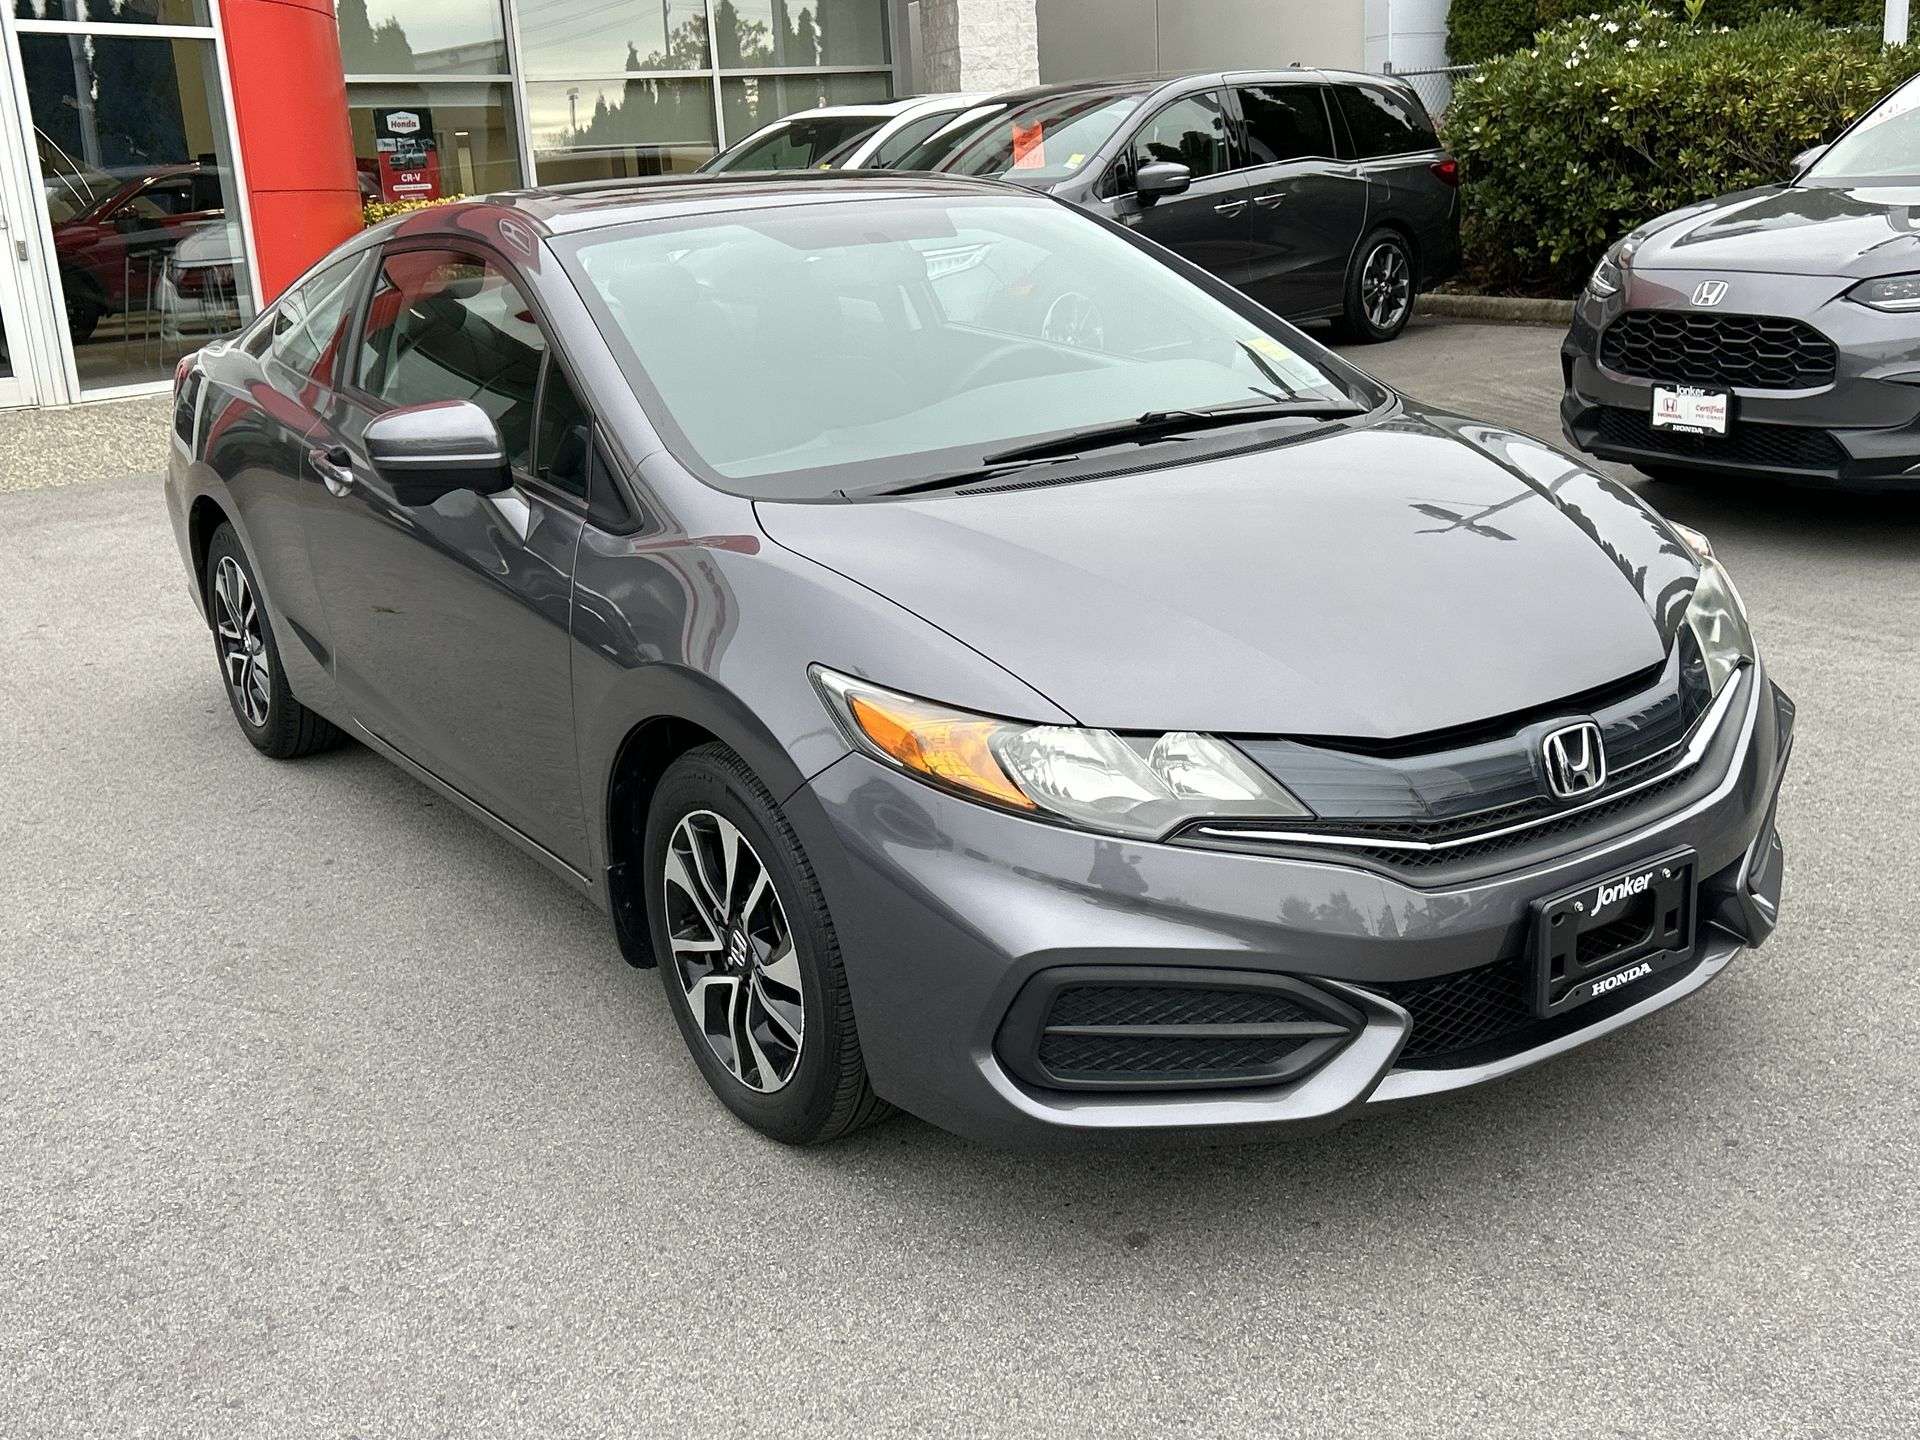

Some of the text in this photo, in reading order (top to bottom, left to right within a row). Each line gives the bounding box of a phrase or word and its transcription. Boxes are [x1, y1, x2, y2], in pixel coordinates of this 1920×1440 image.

[401, 172, 421, 182] CR-V
[1676, 384, 1706, 398] Jonker
[1672, 424, 1704, 434] HONDA
[1590, 872, 1653, 917] Jonker
[1591, 962, 1652, 996] HONDA
